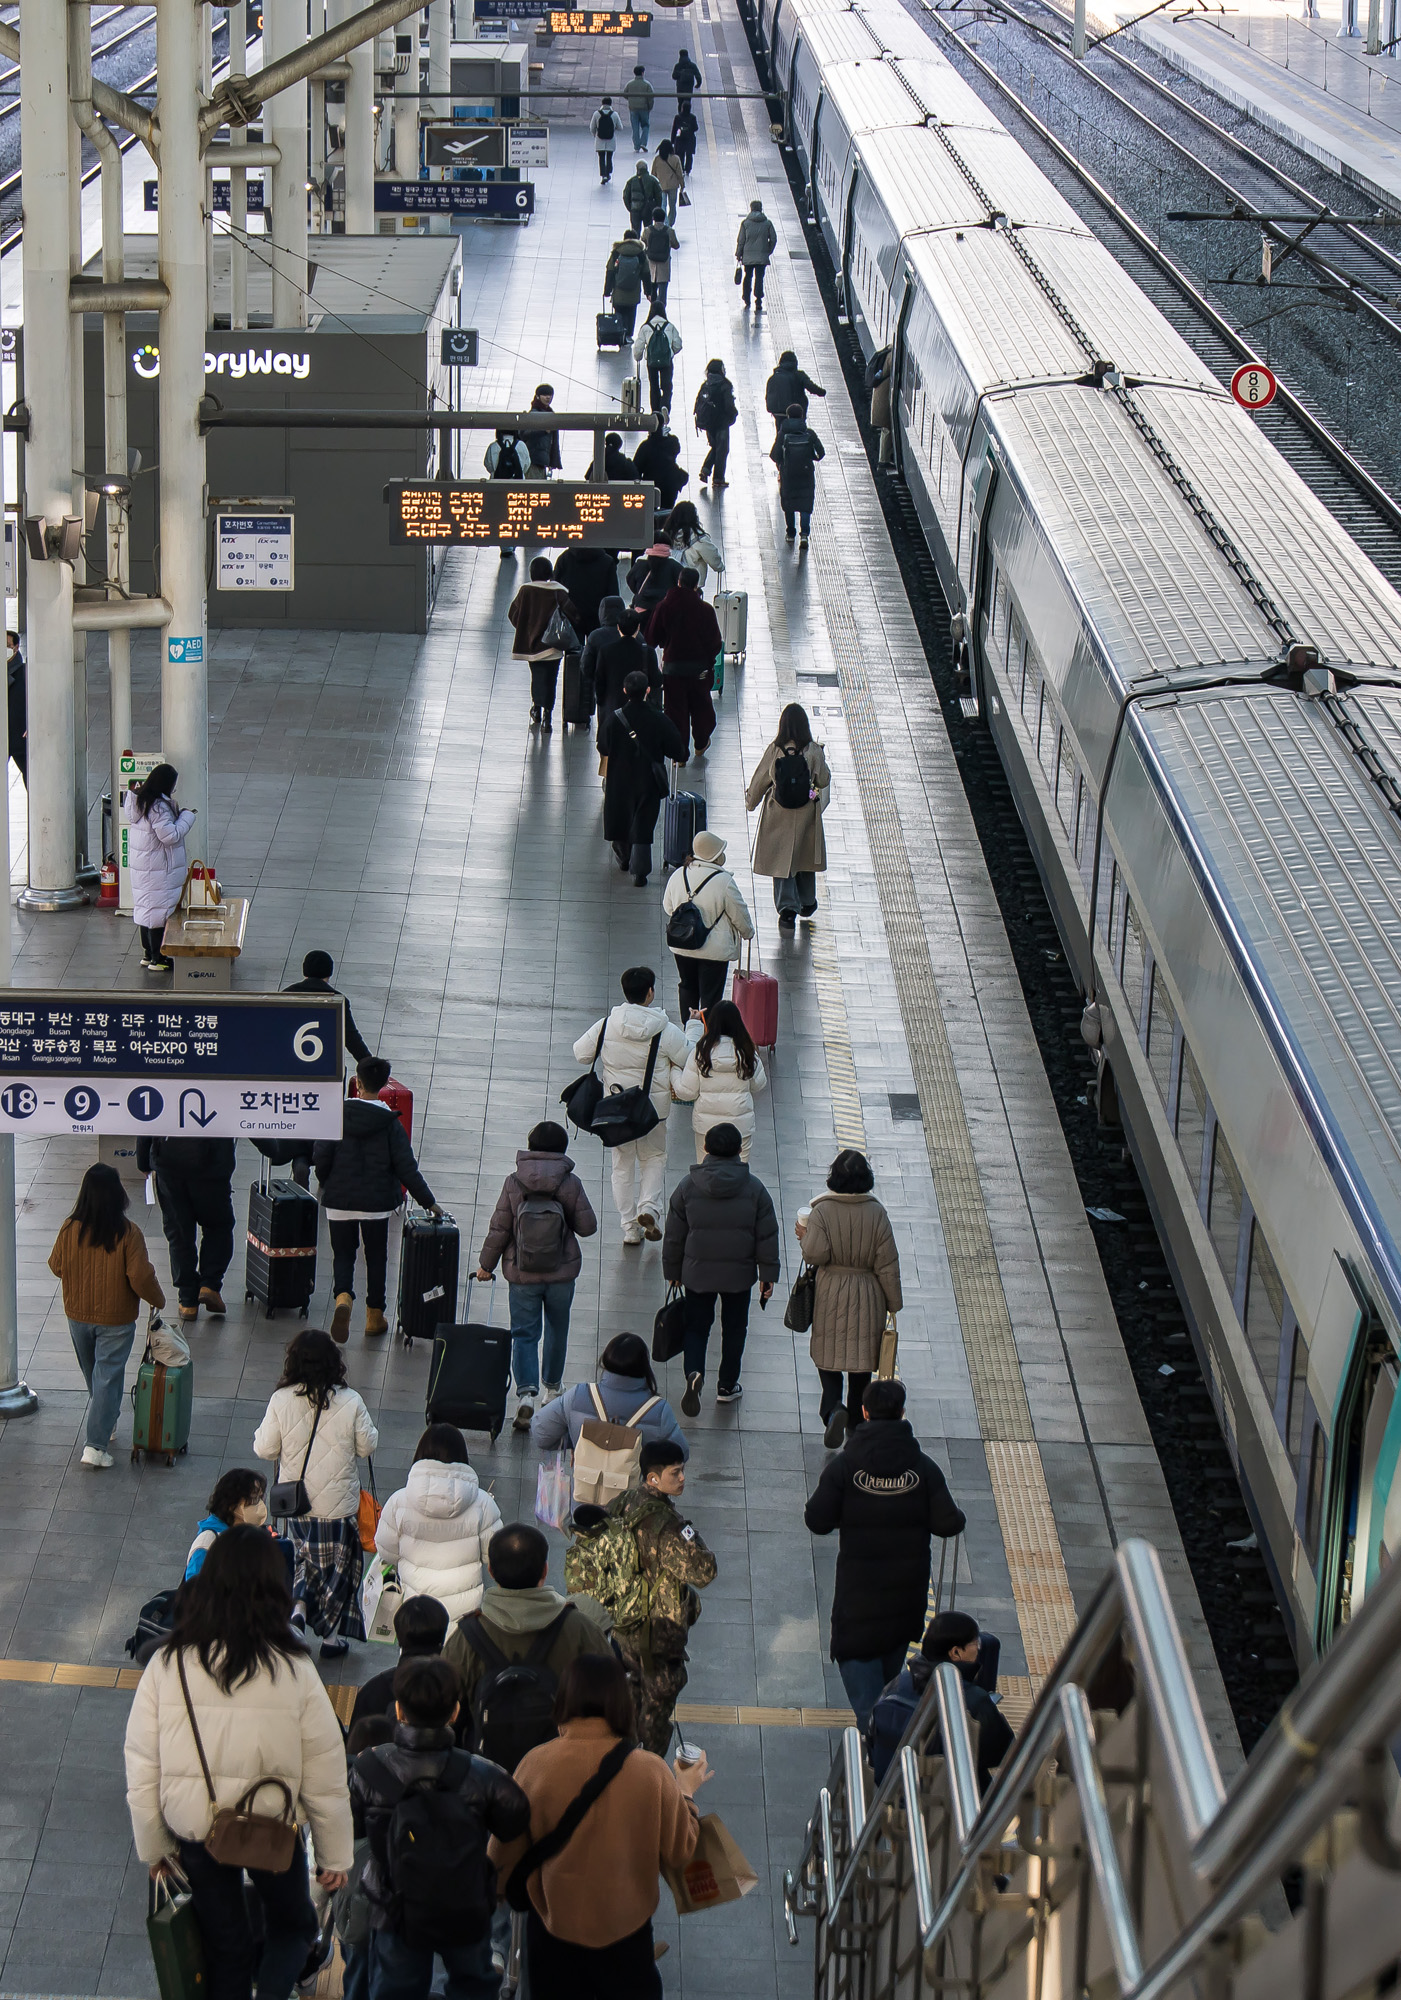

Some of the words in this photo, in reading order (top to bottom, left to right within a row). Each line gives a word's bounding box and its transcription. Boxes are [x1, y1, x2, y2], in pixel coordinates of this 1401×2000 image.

[515, 190, 528, 207] 6
[204, 348, 310, 379] oryWay
[449, 355, 470, 363] 편의점
[1248, 371, 1259, 386] 8
[1249, 387, 1258, 402] 6
[449, 491, 484, 506] 도착역
[507, 492, 551, 507] 열차종류
[622, 494, 646, 509] 방향
[450, 506, 482, 522] 부산
[580, 508, 605, 522] 021
[224, 520, 254, 530] 호차번호
[406, 522, 452, 537] 동대구
[460, 523, 491, 538] 경주
[186, 639, 202, 650] AED
[188, 970, 216, 979] KORAIL
[0, 1011, 36, 1026] 동대구
[48, 1012, 73, 1026] 부산
[84, 1013, 110, 1027] 포항
[121, 1013, 145, 1028] 진주
[158, 1014, 183, 1028] 마산
[194, 1015, 218, 1030] 강릉
[0, 1026, 35, 1037] Dongdaegu
[49, 1027, 71, 1036] Busan
[82, 1028, 108, 1037] Pohang
[129, 1030, 146, 1038] Jinju
[158, 1030, 182, 1038] Masan
[188, 1030, 219, 1040] Gangneung
[0, 1038, 21, 1052] 익산
[32, 1039, 81, 1053] 광주송정
[93, 1040, 117, 1054] 목포
[129, 1040, 188, 1055] 여수EXPO
[193, 1042, 218, 1056] 방면
[292, 1020, 325, 1063] 6
[2, 1053, 20, 1062] Iksan
[31, 1054, 55, 1064] Gwangju
[54, 1055, 82, 1064] songjeong
[93, 1055, 117, 1064] Mokpo
[144, 1056, 166, 1065] Yeosu
[166, 1056, 185, 1066] Expo
[2, 1088, 36, 1114] 18
[73, 1091, 90, 1116] 9
[239, 1090, 321, 1115] 호차번호
[71, 1124, 94, 1133] 현위치
[239, 1119, 256, 1131] Car
[257, 1119, 297, 1131] number
